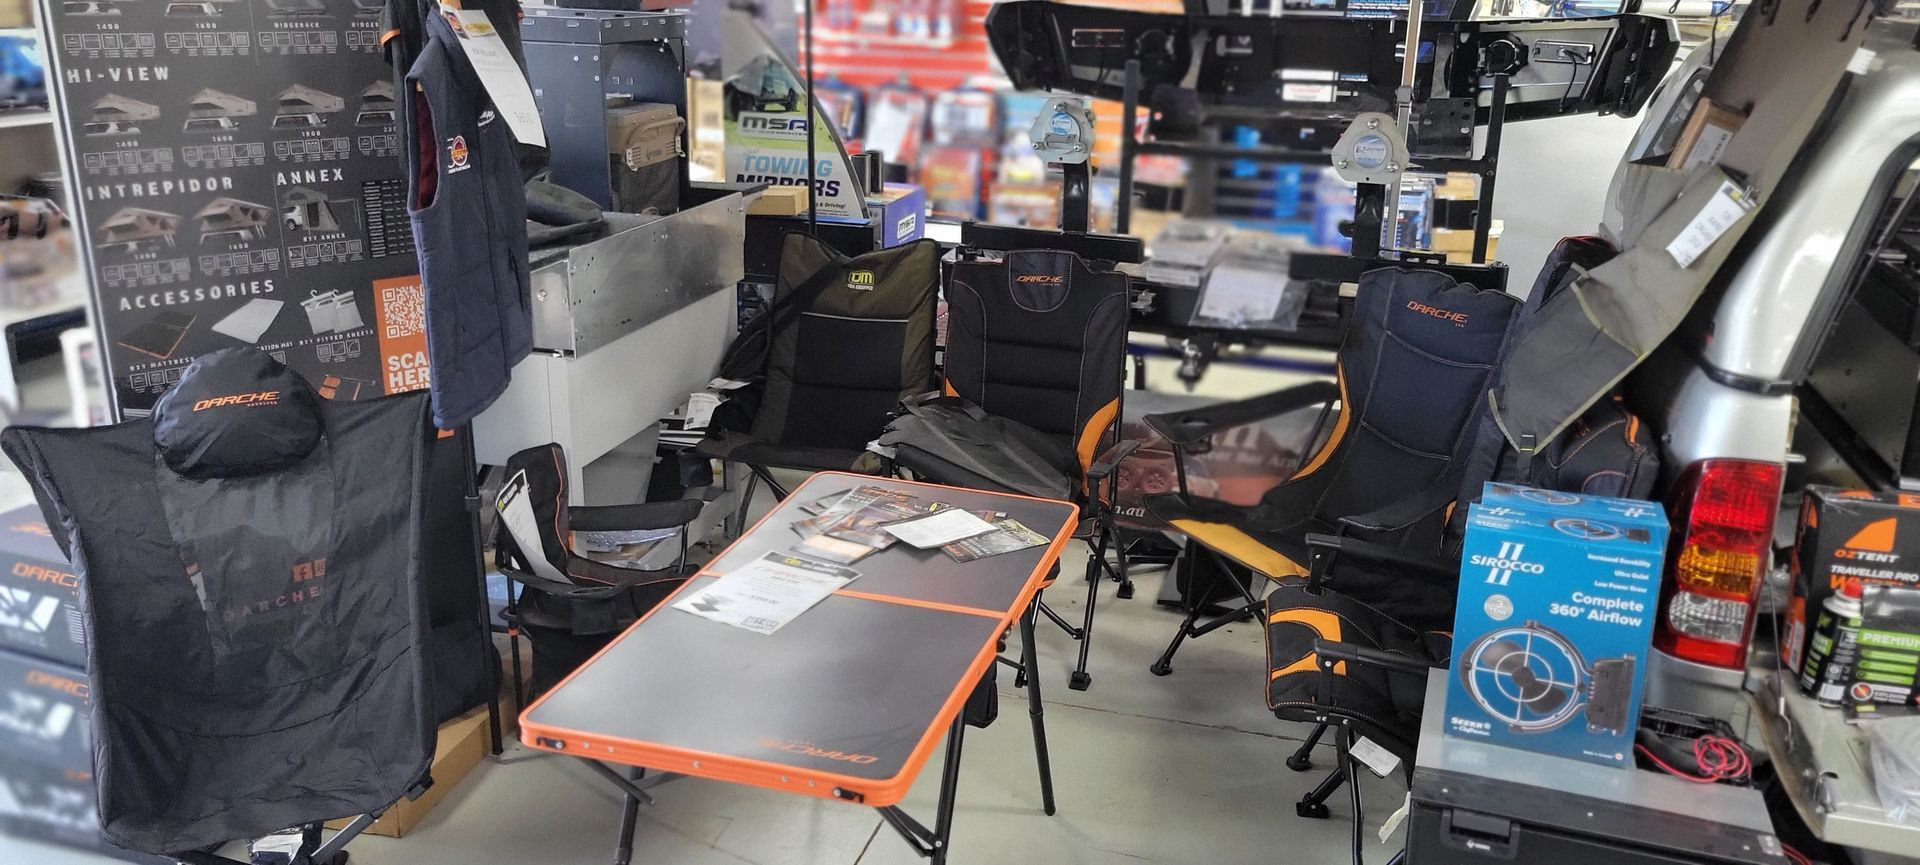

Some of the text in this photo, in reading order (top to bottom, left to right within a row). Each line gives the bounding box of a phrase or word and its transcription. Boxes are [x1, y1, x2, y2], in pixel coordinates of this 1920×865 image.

[66, 66, 169, 84] HI-VIEW
[742, 117, 808, 132] MSA
[276, 168, 344, 186] ANNEX
[86, 176, 234, 201] INTREPIDOR
[1016, 275, 1063, 283] DARCHE
[120, 279, 275, 311] ACCESSORIES
[1406, 300, 1468, 323] DARCHE
[150, 356, 195, 368] MATTRESS
[387, 351, 428, 371] SCA
[390, 367, 430, 388] HER
[193, 391, 280, 412] DARCHE
[1470, 554, 1545, 575] SIROCCO
[1587, 553, 1651, 568] Increased Durability
[1834, 549, 1899, 563] OZTENT
[12, 562, 77, 587] DARC
[1614, 570, 1630, 578] Ultra
[1831, 565, 1895, 579] TRAVELLER
[1895, 572, 1920, 582] PRO
[1594, 580, 1608, 588] Low
[1608, 582, 1629, 591] Power
[1571, 591, 1645, 613] Complete
[1550, 603, 1643, 627] 360° Airflow
[1451, 717, 1482, 729] SEEKR
